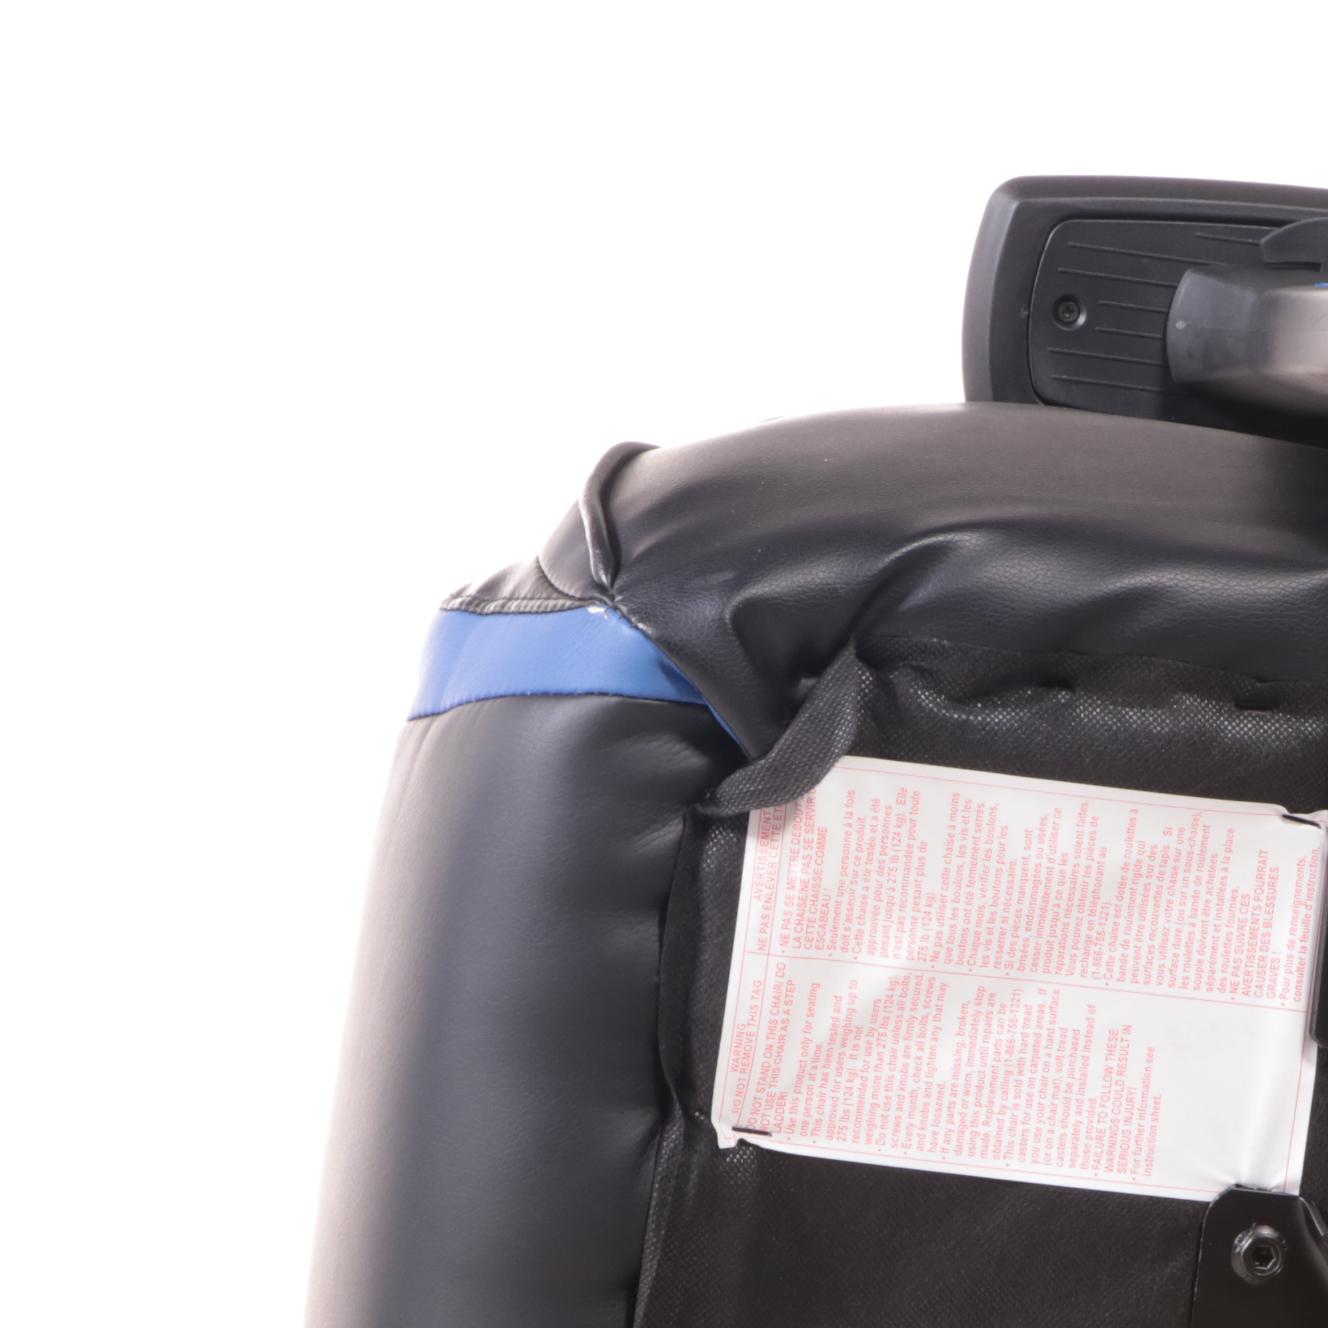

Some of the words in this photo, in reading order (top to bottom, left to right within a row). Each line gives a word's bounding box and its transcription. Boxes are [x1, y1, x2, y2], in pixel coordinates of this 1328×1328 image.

[1238, 892, 1251, 914] CES
[1262, 866, 1279, 928] BLESSURES
[1233, 916, 1248, 954] SUIVRE
[1241, 904, 1262, 996] AVERTISSEMENTS
[1252, 848, 1268, 902] POURRAIT
[1258, 930, 1271, 952] DES
[1228, 980, 1240, 994] NE
[1230, 957, 1243, 978] PAS
[1253, 954, 1267, 997] CAUSER
[1265, 956, 1280, 999] GRAVES
[750, 979, 763, 1000] TAG
[745, 1003, 759, 1027] THIS
[1121, 1023, 1132, 1035] IN
[730, 1023, 746, 1072] WARNING
[738, 1031, 755, 1074] REMOVE
[1104, 1028, 1119, 1061] THESE
[1115, 1036, 1130, 1077] RESULT
[1098, 1064, 1114, 1108] FOLLOW
[1111, 1078, 1125, 1115] COULD
[1096, 1109, 1108, 1124] TO
[1091, 1127, 1106, 1170] FAILURE
[1105, 1117, 1120, 1172] WARNINGS
[1116, 1128, 1132, 1173] SERIOUS
